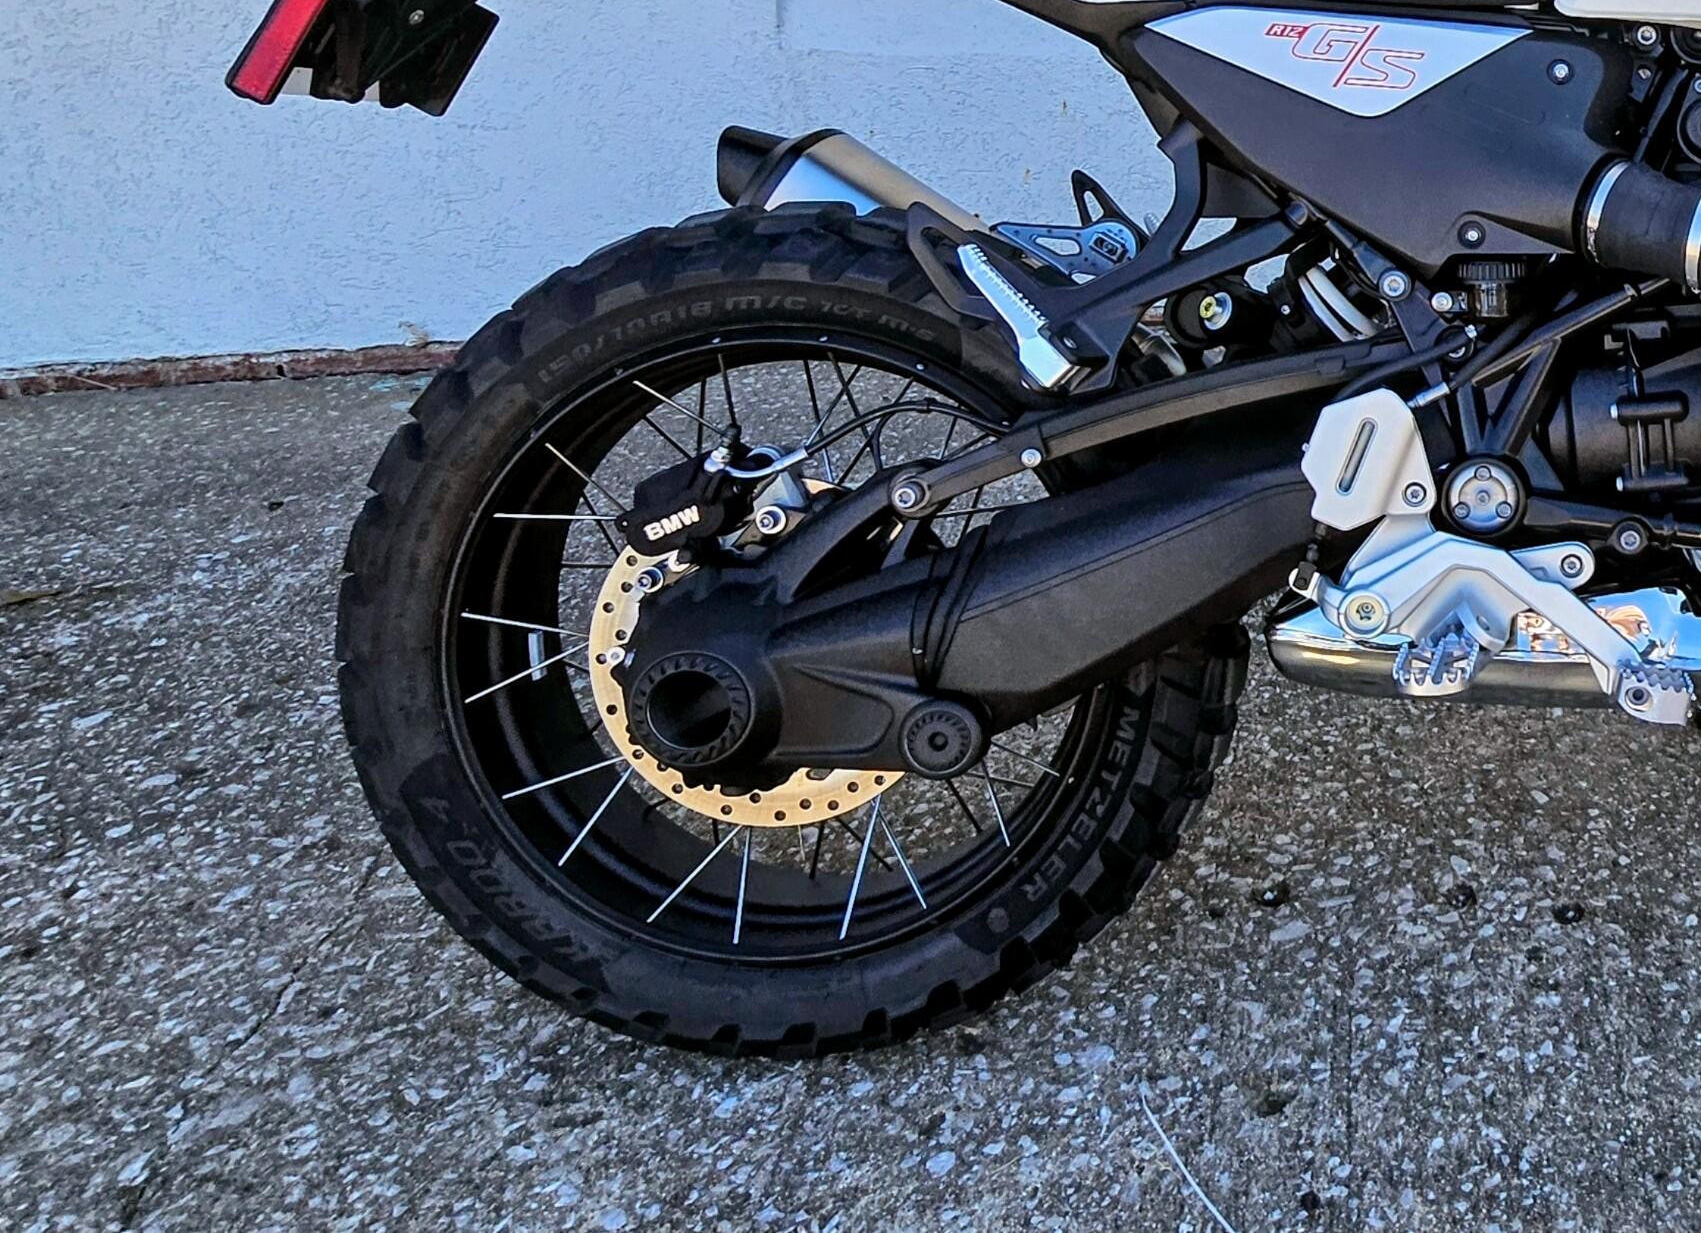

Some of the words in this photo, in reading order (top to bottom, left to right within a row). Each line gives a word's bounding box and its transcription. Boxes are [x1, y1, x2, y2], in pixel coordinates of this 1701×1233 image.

[1268, 24, 1305, 38] R12
[1292, 22, 1425, 89] G/S
[643, 505, 700, 541] BMW
[1019, 704, 1142, 902] METZELER
